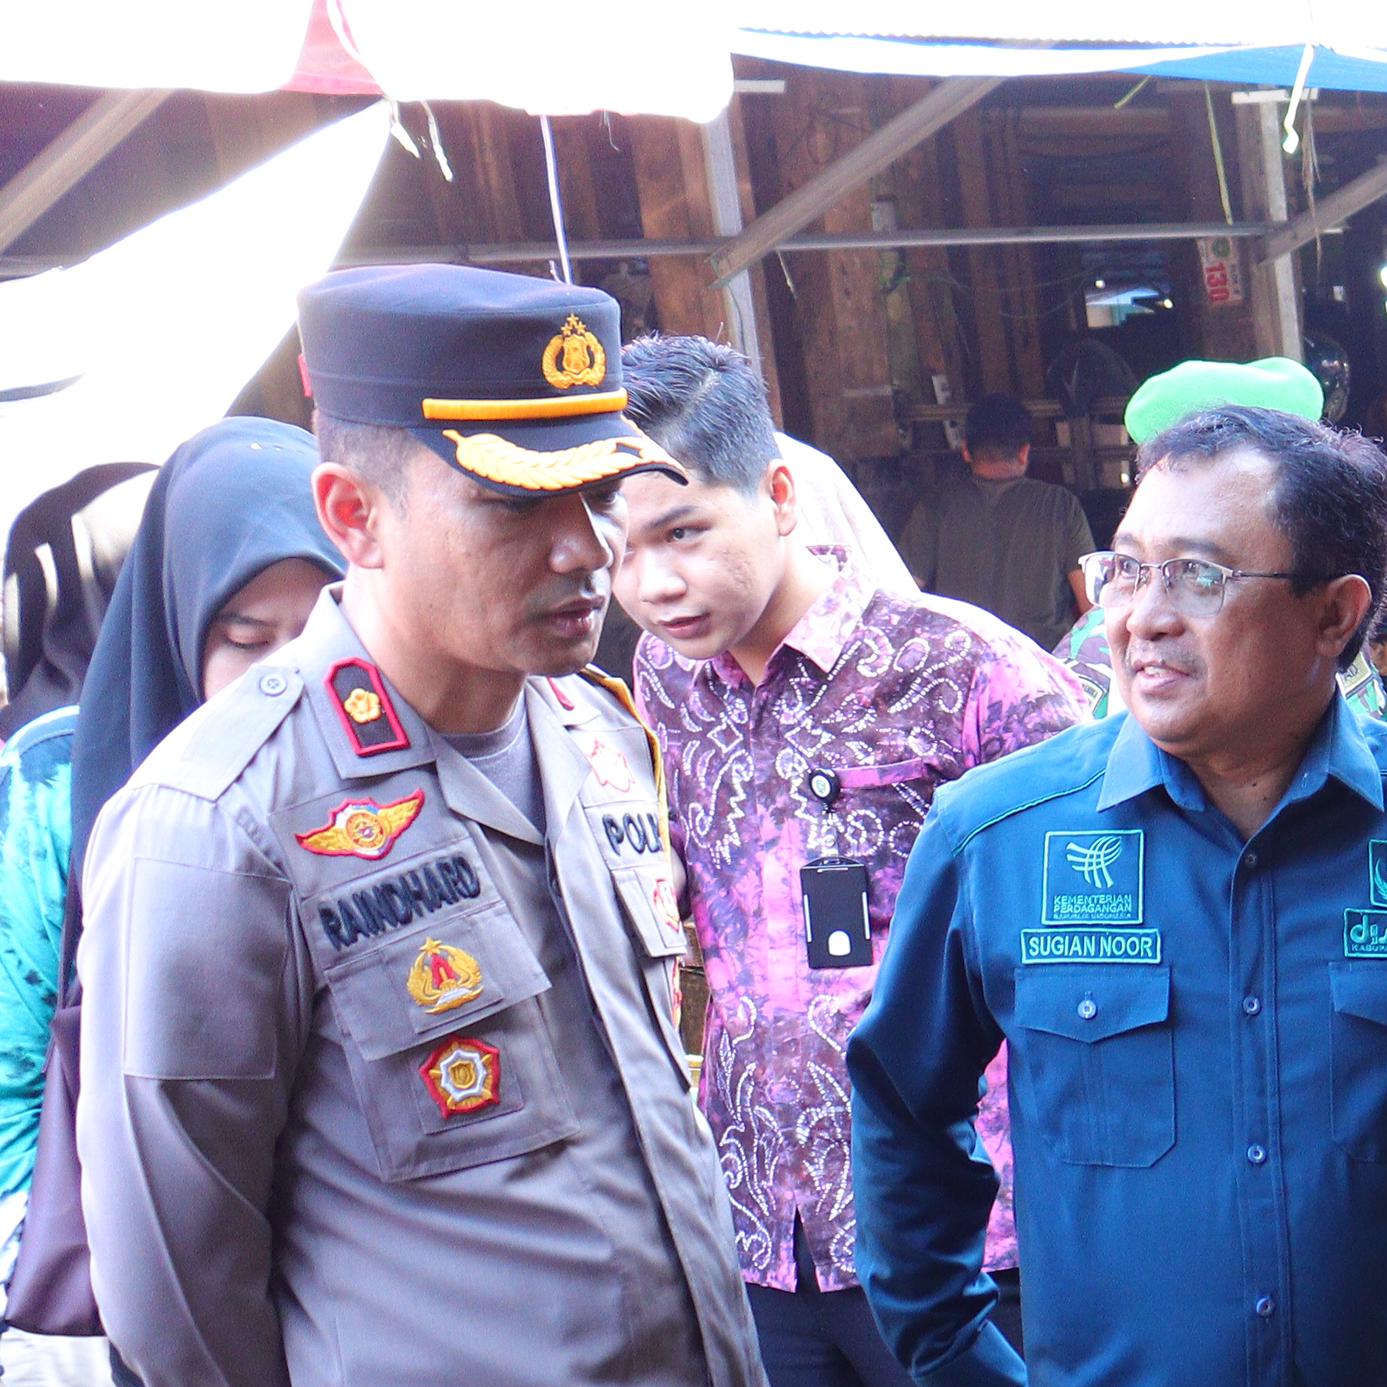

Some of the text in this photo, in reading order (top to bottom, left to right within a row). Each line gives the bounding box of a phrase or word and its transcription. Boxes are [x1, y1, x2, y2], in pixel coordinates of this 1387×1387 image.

[318, 856, 481, 951] RAINDHARD
[1053, 893, 1132, 905] KEMENTERIAN
[1053, 903, 1132, 914] PERDAGANGAN
[1029, 935, 1153, 957] SUGIAN NOOR
